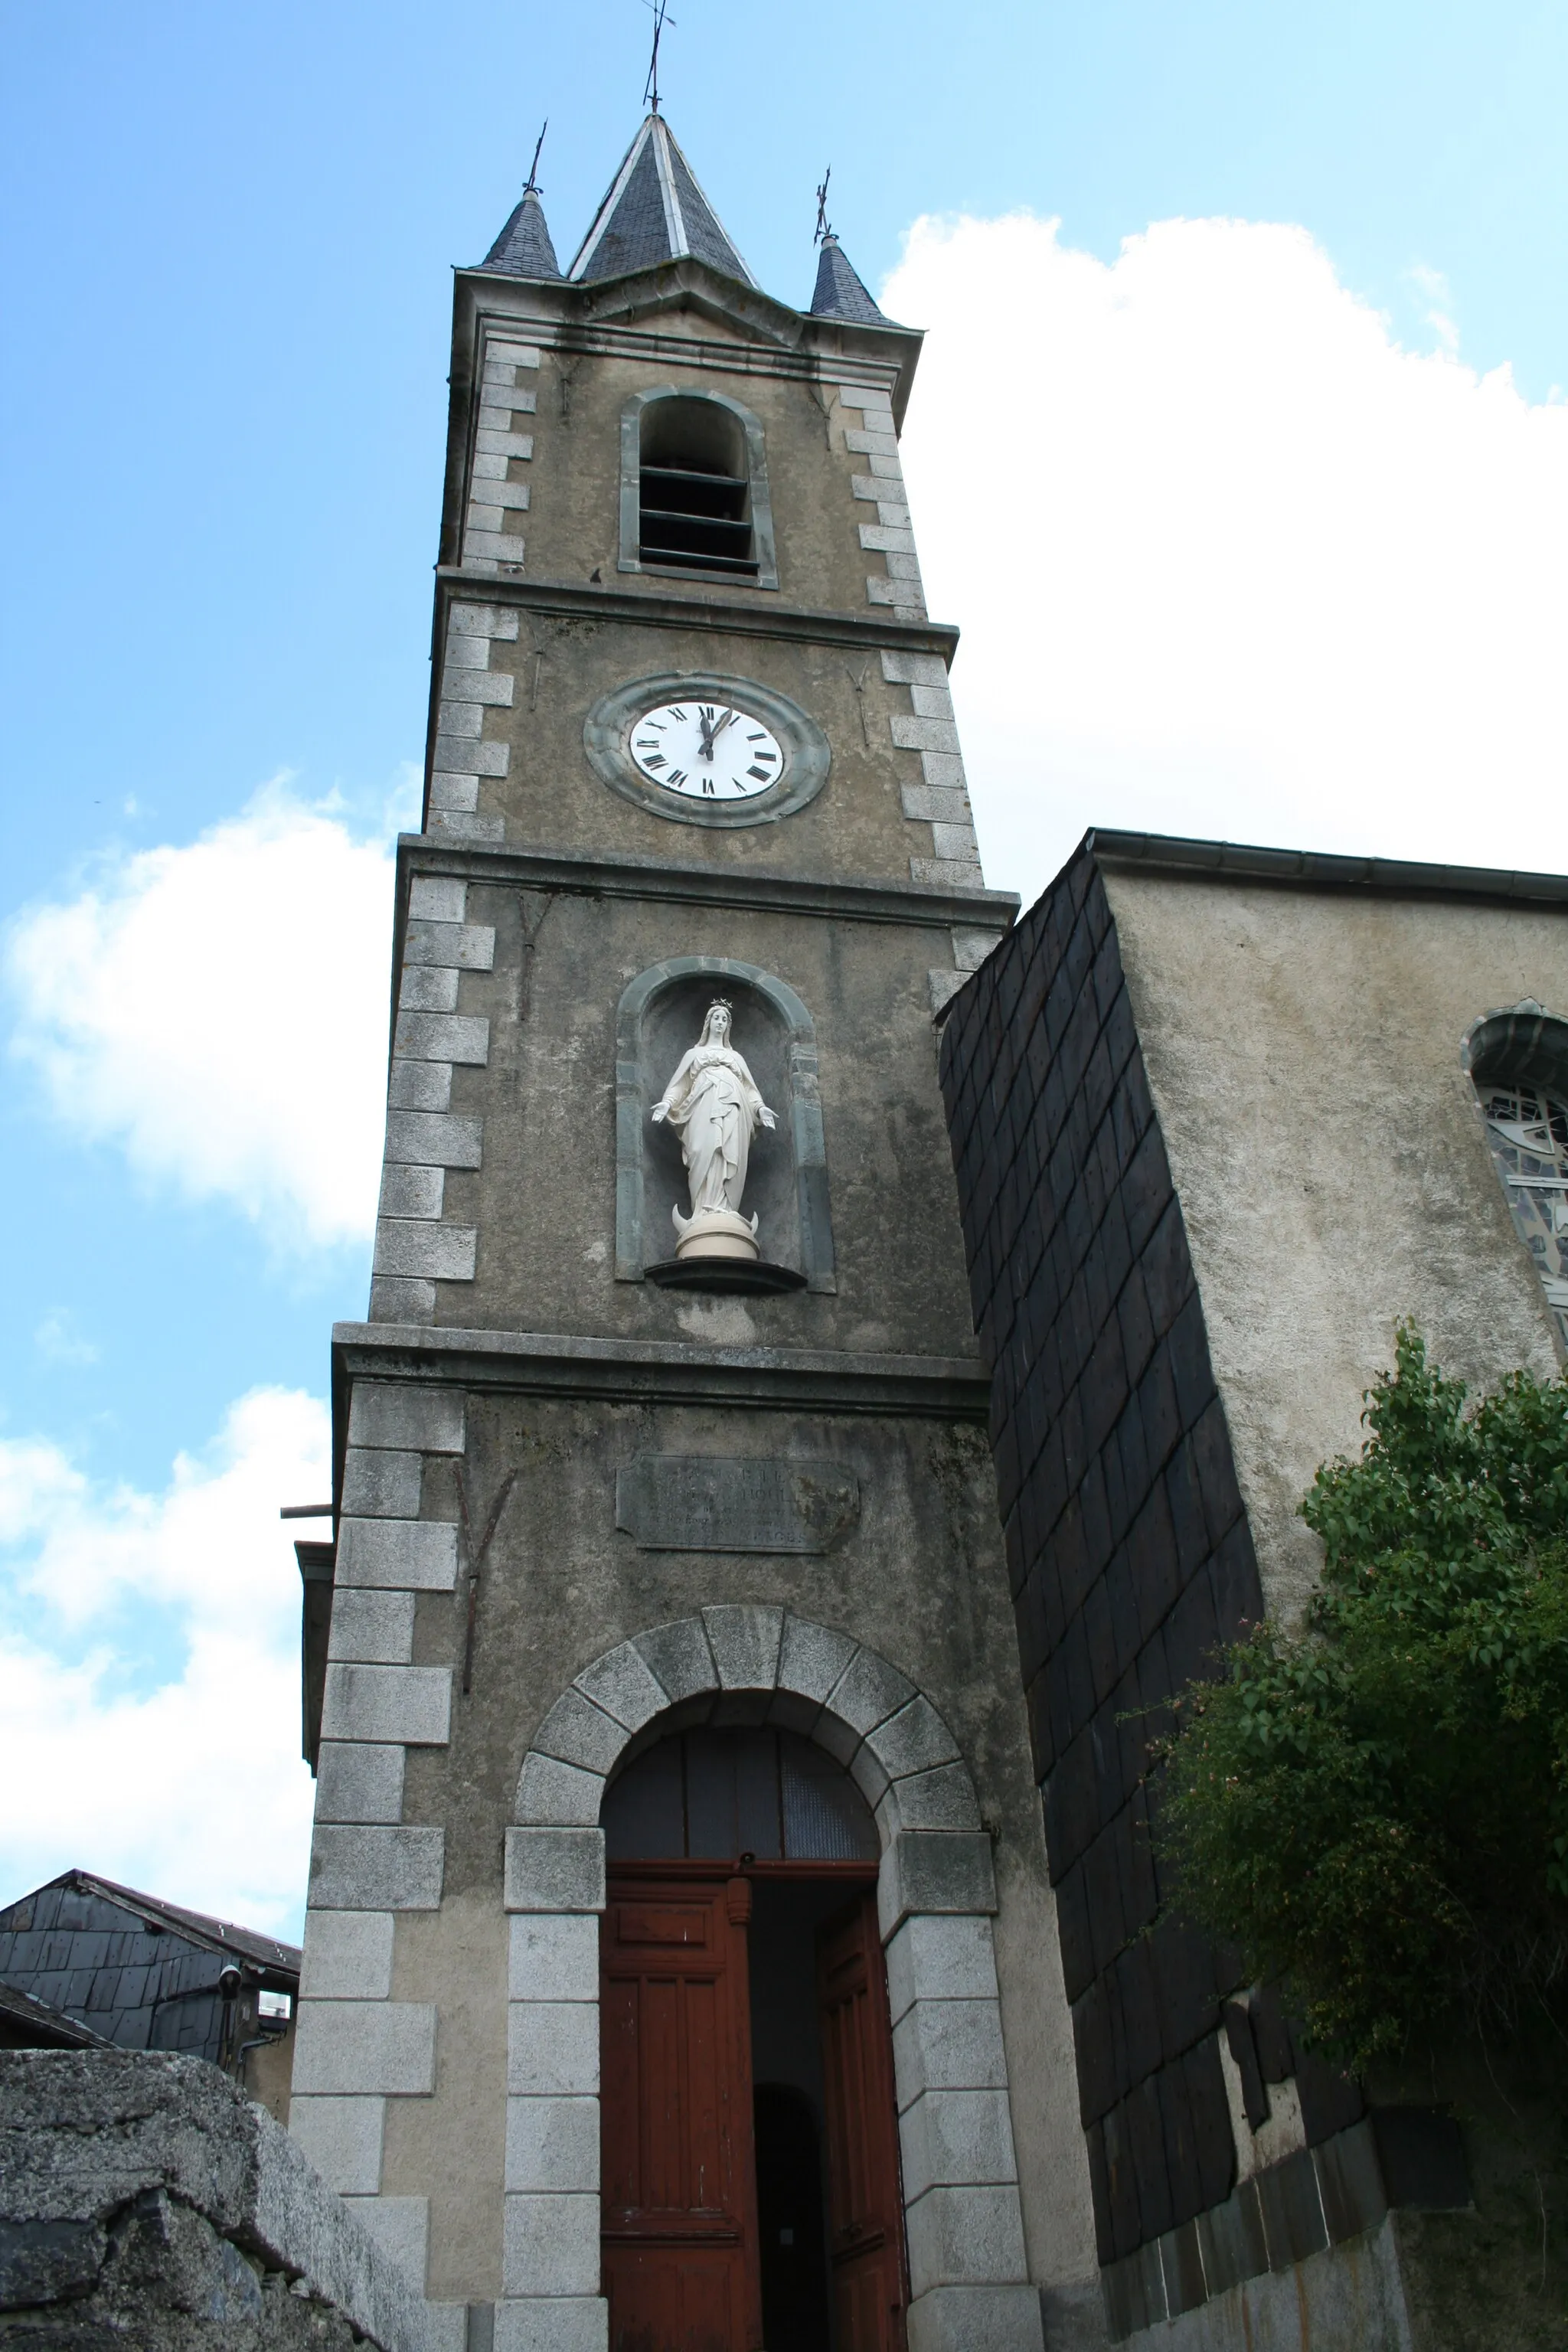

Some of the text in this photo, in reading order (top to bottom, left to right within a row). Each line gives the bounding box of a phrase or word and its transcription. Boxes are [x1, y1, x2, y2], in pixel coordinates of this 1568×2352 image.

[667, 707, 688, 723] XI
[645, 720, 668, 732] X
[636, 738, 660, 749] IX
[746, 733, 767, 742] II
[642, 753, 669, 772] VIII
[754, 751, 776, 763] III
[666, 769, 689, 788] VII
[702, 778, 715, 795] VI
[731, 776, 747, 793] V
